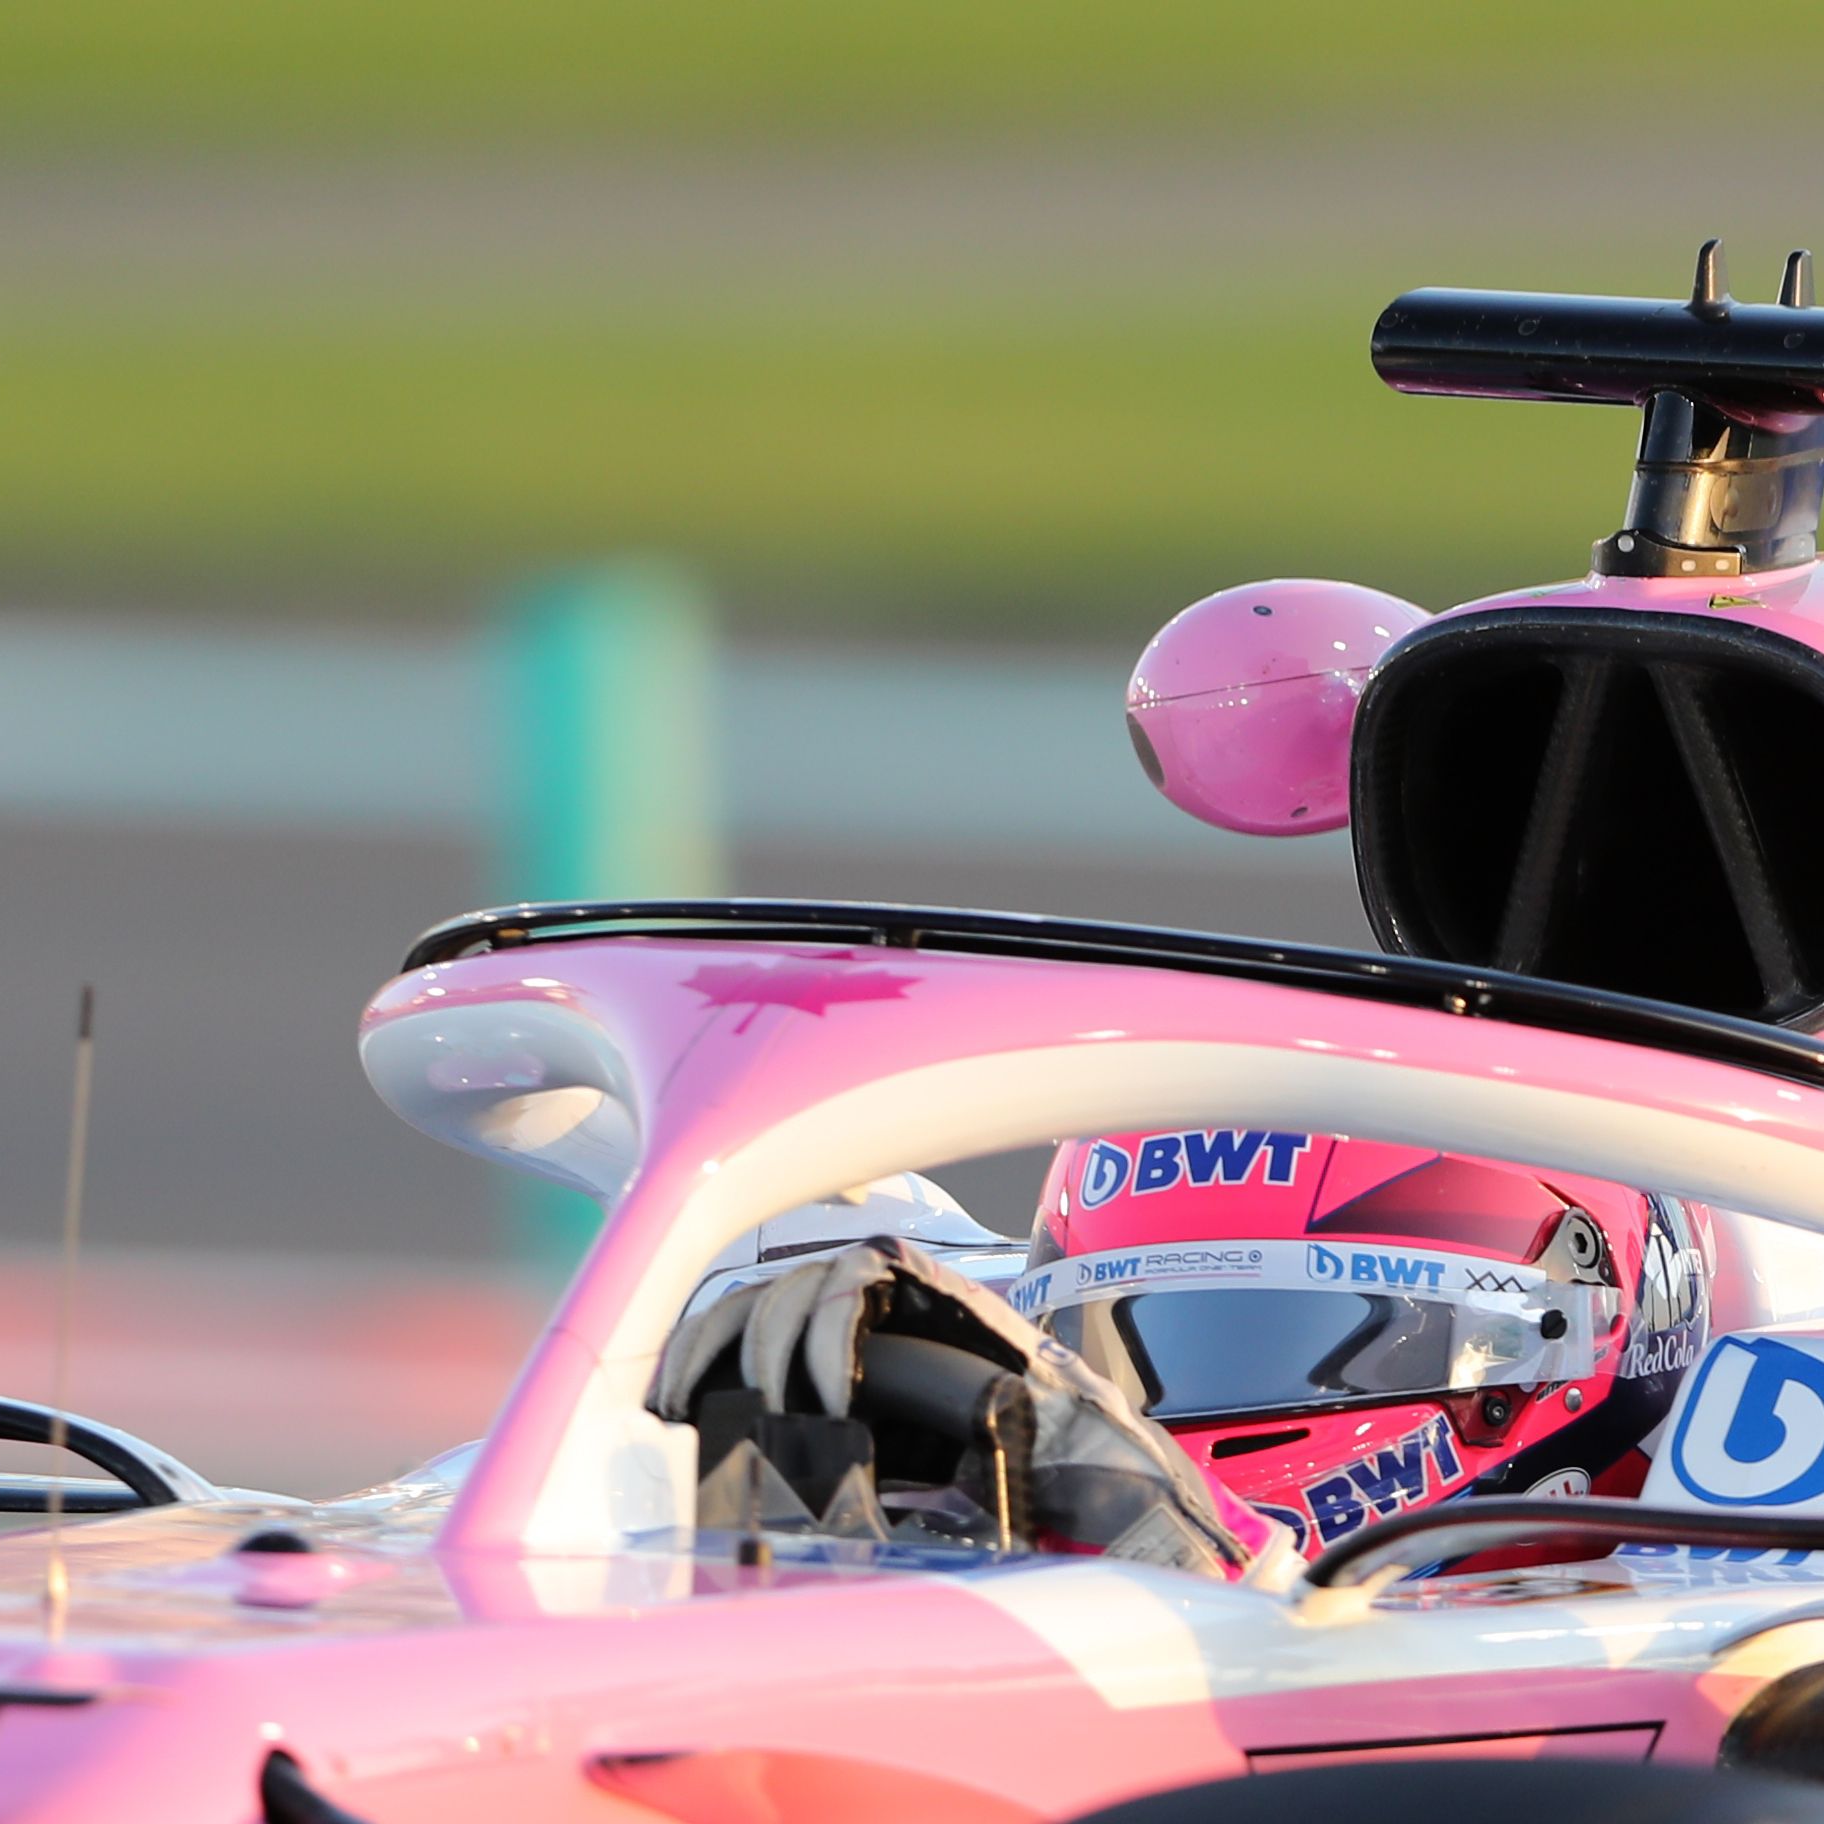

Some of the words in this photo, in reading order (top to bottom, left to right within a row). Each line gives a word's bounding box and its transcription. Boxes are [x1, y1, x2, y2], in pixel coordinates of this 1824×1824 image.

[1133, 1130, 1308, 1195] BWT
[1094, 1257, 1141, 1282] BWT
[1145, 1250, 1243, 1267] RACING
[1350, 1252, 1445, 1293] BWT
[1304, 1413, 1461, 1545] BWT
